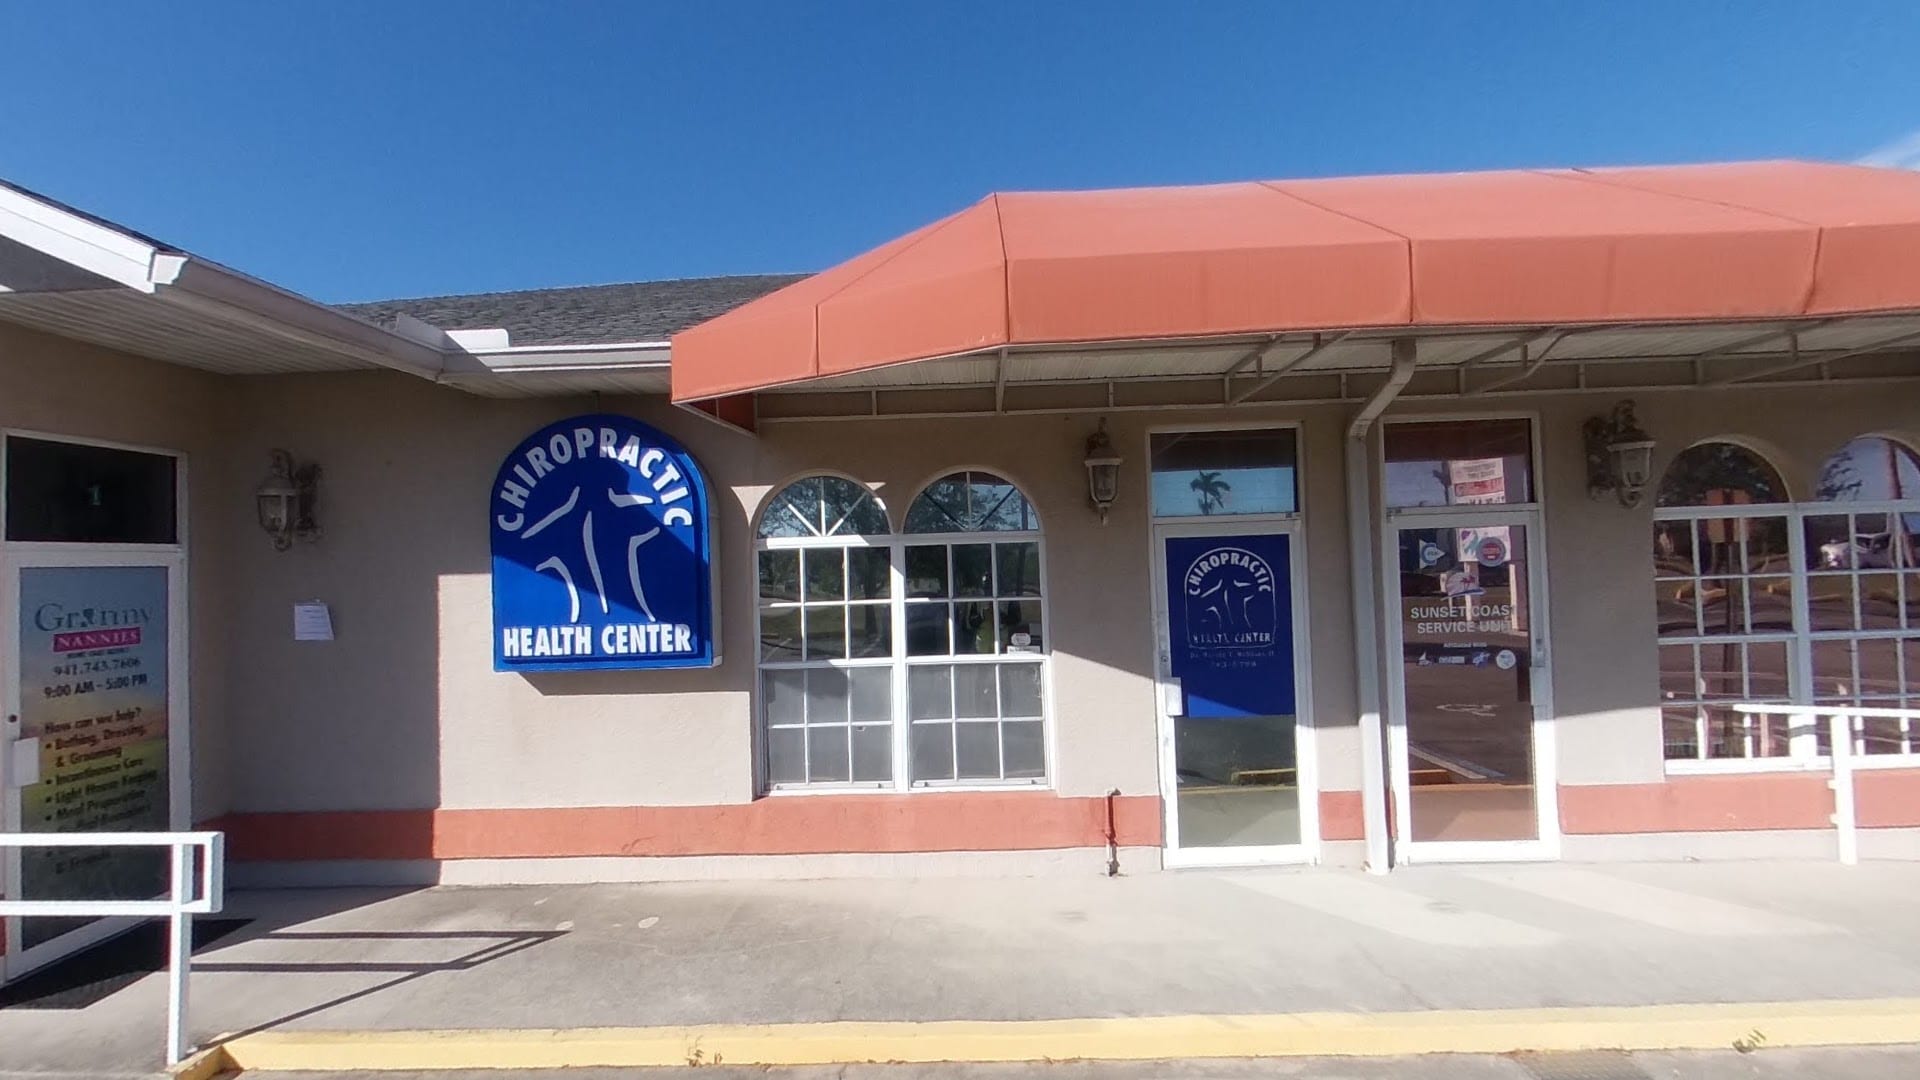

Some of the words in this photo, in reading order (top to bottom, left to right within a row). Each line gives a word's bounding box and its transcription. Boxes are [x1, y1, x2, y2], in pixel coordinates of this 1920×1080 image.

[498, 428, 692, 531] CHIROPRACTIC
[1189, 552, 1271, 595] CHIROPRACTIC
[1410, 606, 1466, 619] SUNSET
[1235, 632, 1271, 643] CENTER
[1417, 621, 1475, 634] SERVICE
[1479, 620, 1514, 632] UNIT
[58, 630, 139, 648] NANNIES
[503, 626, 592, 656] HEALTH
[601, 624, 692, 654] CENTER
[44, 684, 71, 698] 9:00
[75, 681, 95, 694] AM
[132, 673, 148, 686] PM
